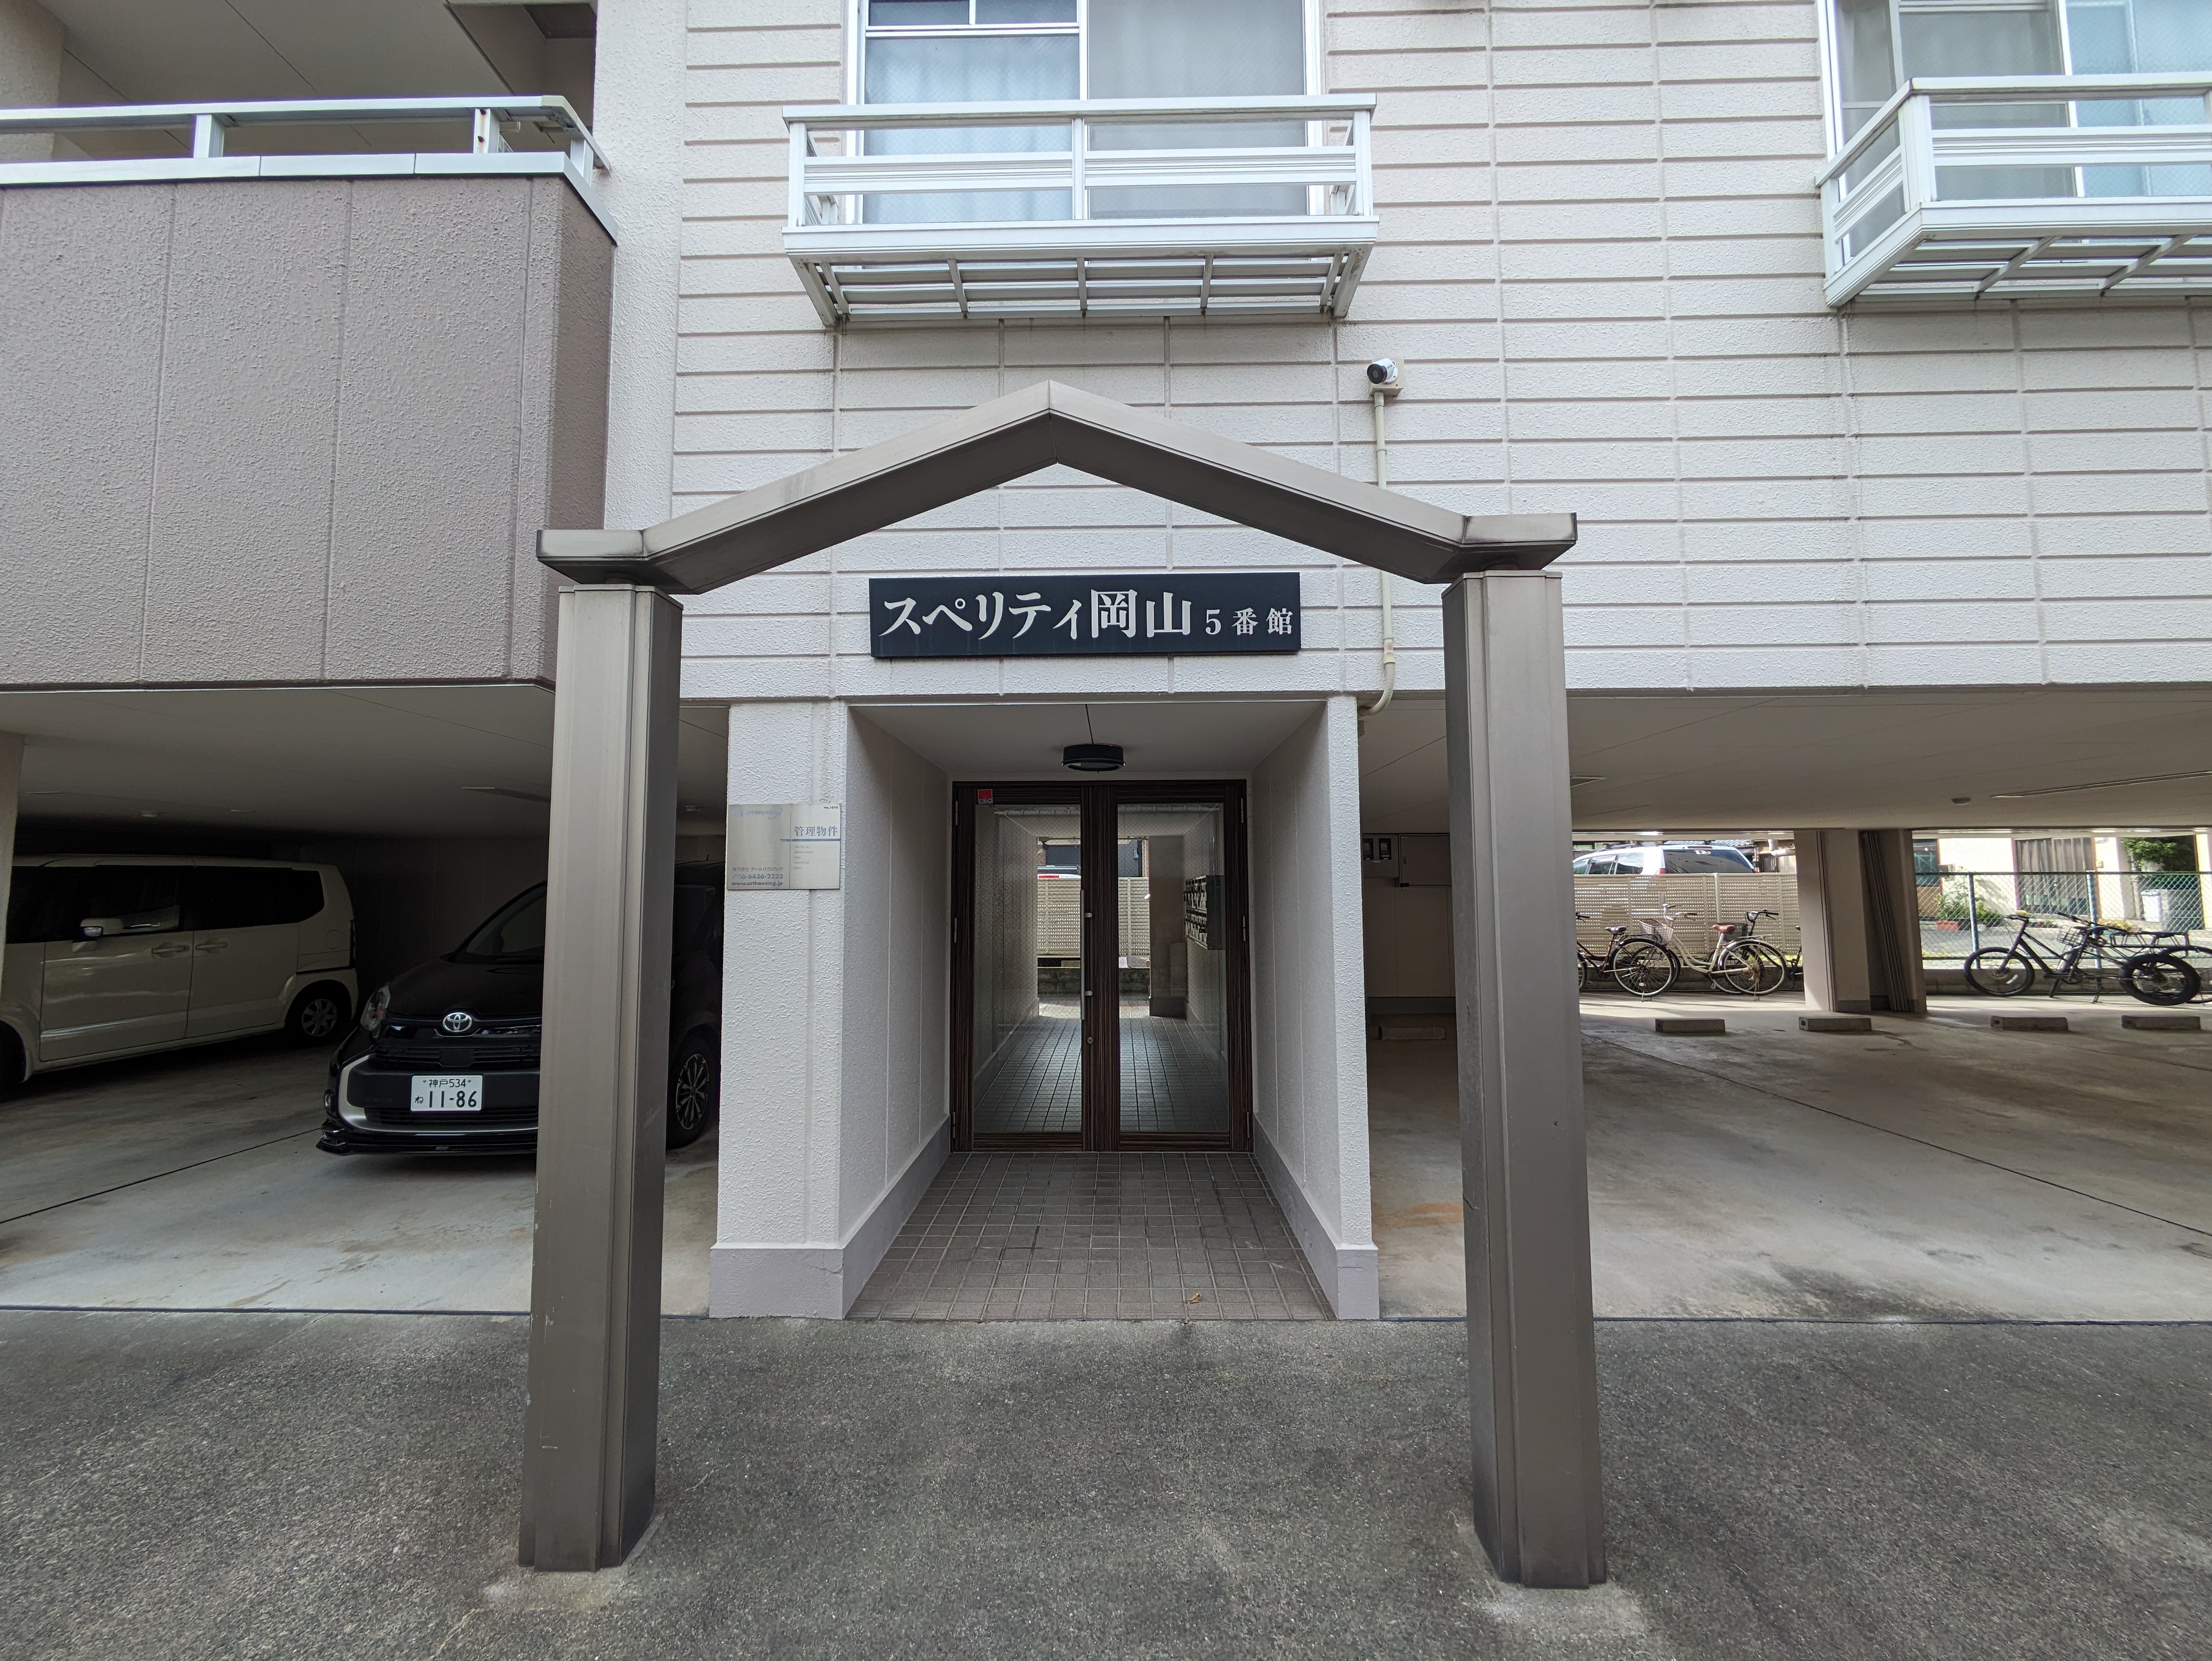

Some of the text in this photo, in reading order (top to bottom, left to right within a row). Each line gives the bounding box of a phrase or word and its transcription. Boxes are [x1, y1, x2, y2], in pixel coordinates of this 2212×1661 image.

[794, 826, 838, 836] 管理物件
[414, 1090, 477, 1107] ね 11-86
